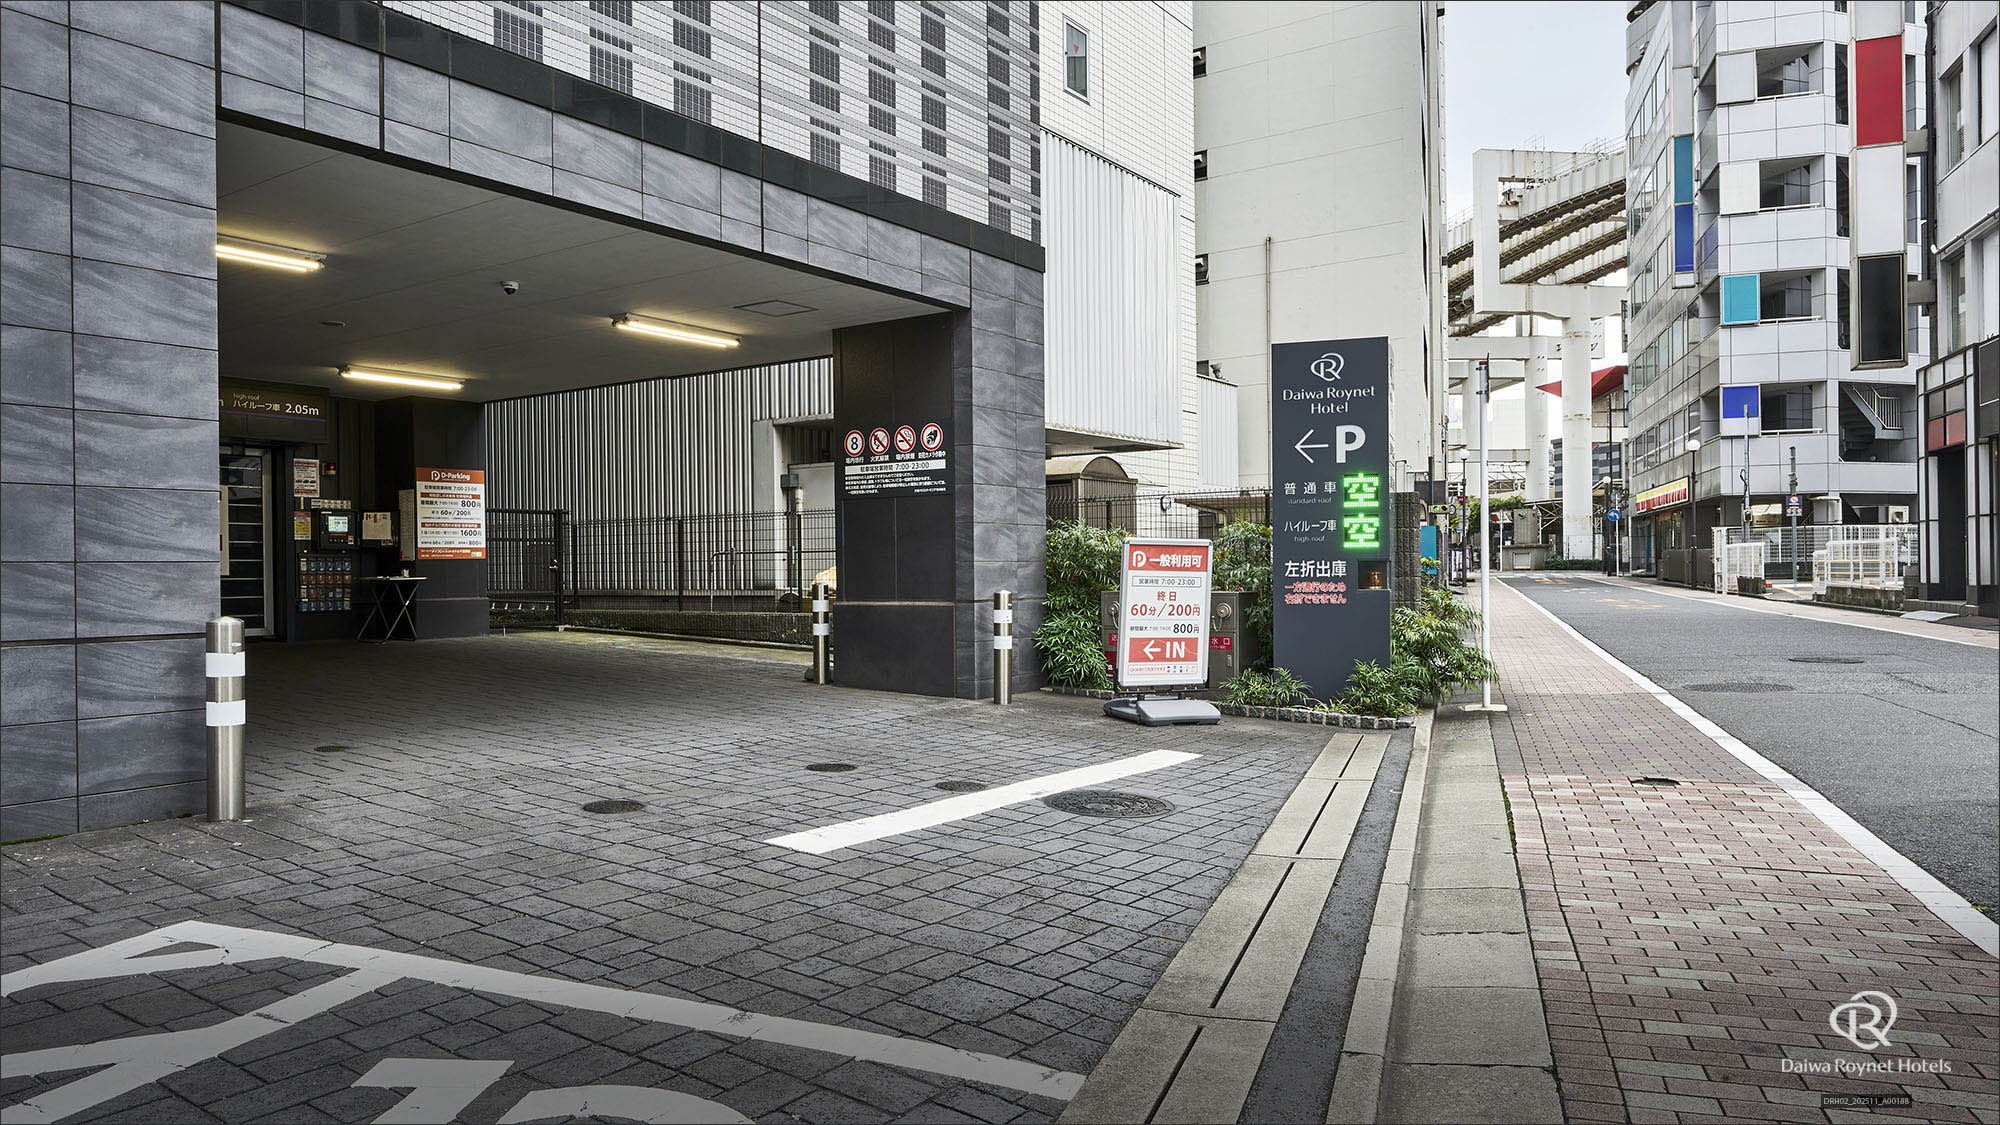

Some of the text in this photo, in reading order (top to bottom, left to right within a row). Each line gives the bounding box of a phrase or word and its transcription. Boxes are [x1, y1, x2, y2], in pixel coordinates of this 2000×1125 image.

[1282, 385, 1375, 401] Daiwa Roynet
[233, 400, 281, 411] ハイルーフ車
[285, 403, 319, 415] 2.05m
[1310, 401, 1349, 414] Hotel
[851, 437, 858, 450] 8
[1335, 424, 1366, 464] P
[895, 461, 930, 470] 7:00-23:00
[441, 472, 470, 481] D-Parking
[1283, 481, 1337, 495] 普通車
[1343, 472, 1379, 508] 空
[1284, 519, 1337, 532] ハイルーフ車
[1343, 513, 1379, 548] 空
[1149, 553, 1203, 568] 一般利用可
[1284, 560, 1347, 578] 左折出庫
[1161, 578, 1196, 586] 7:00-23:00
[1284, 581, 1347, 593] 一方通行のため
[1156, 591, 1177, 602] 終日
[1284, 593, 1347, 605] 右折できません
[1130, 602, 1201, 618] 60分/200円
[1173, 623, 1200, 634] 800円
[1165, 641, 1185, 659] IN
